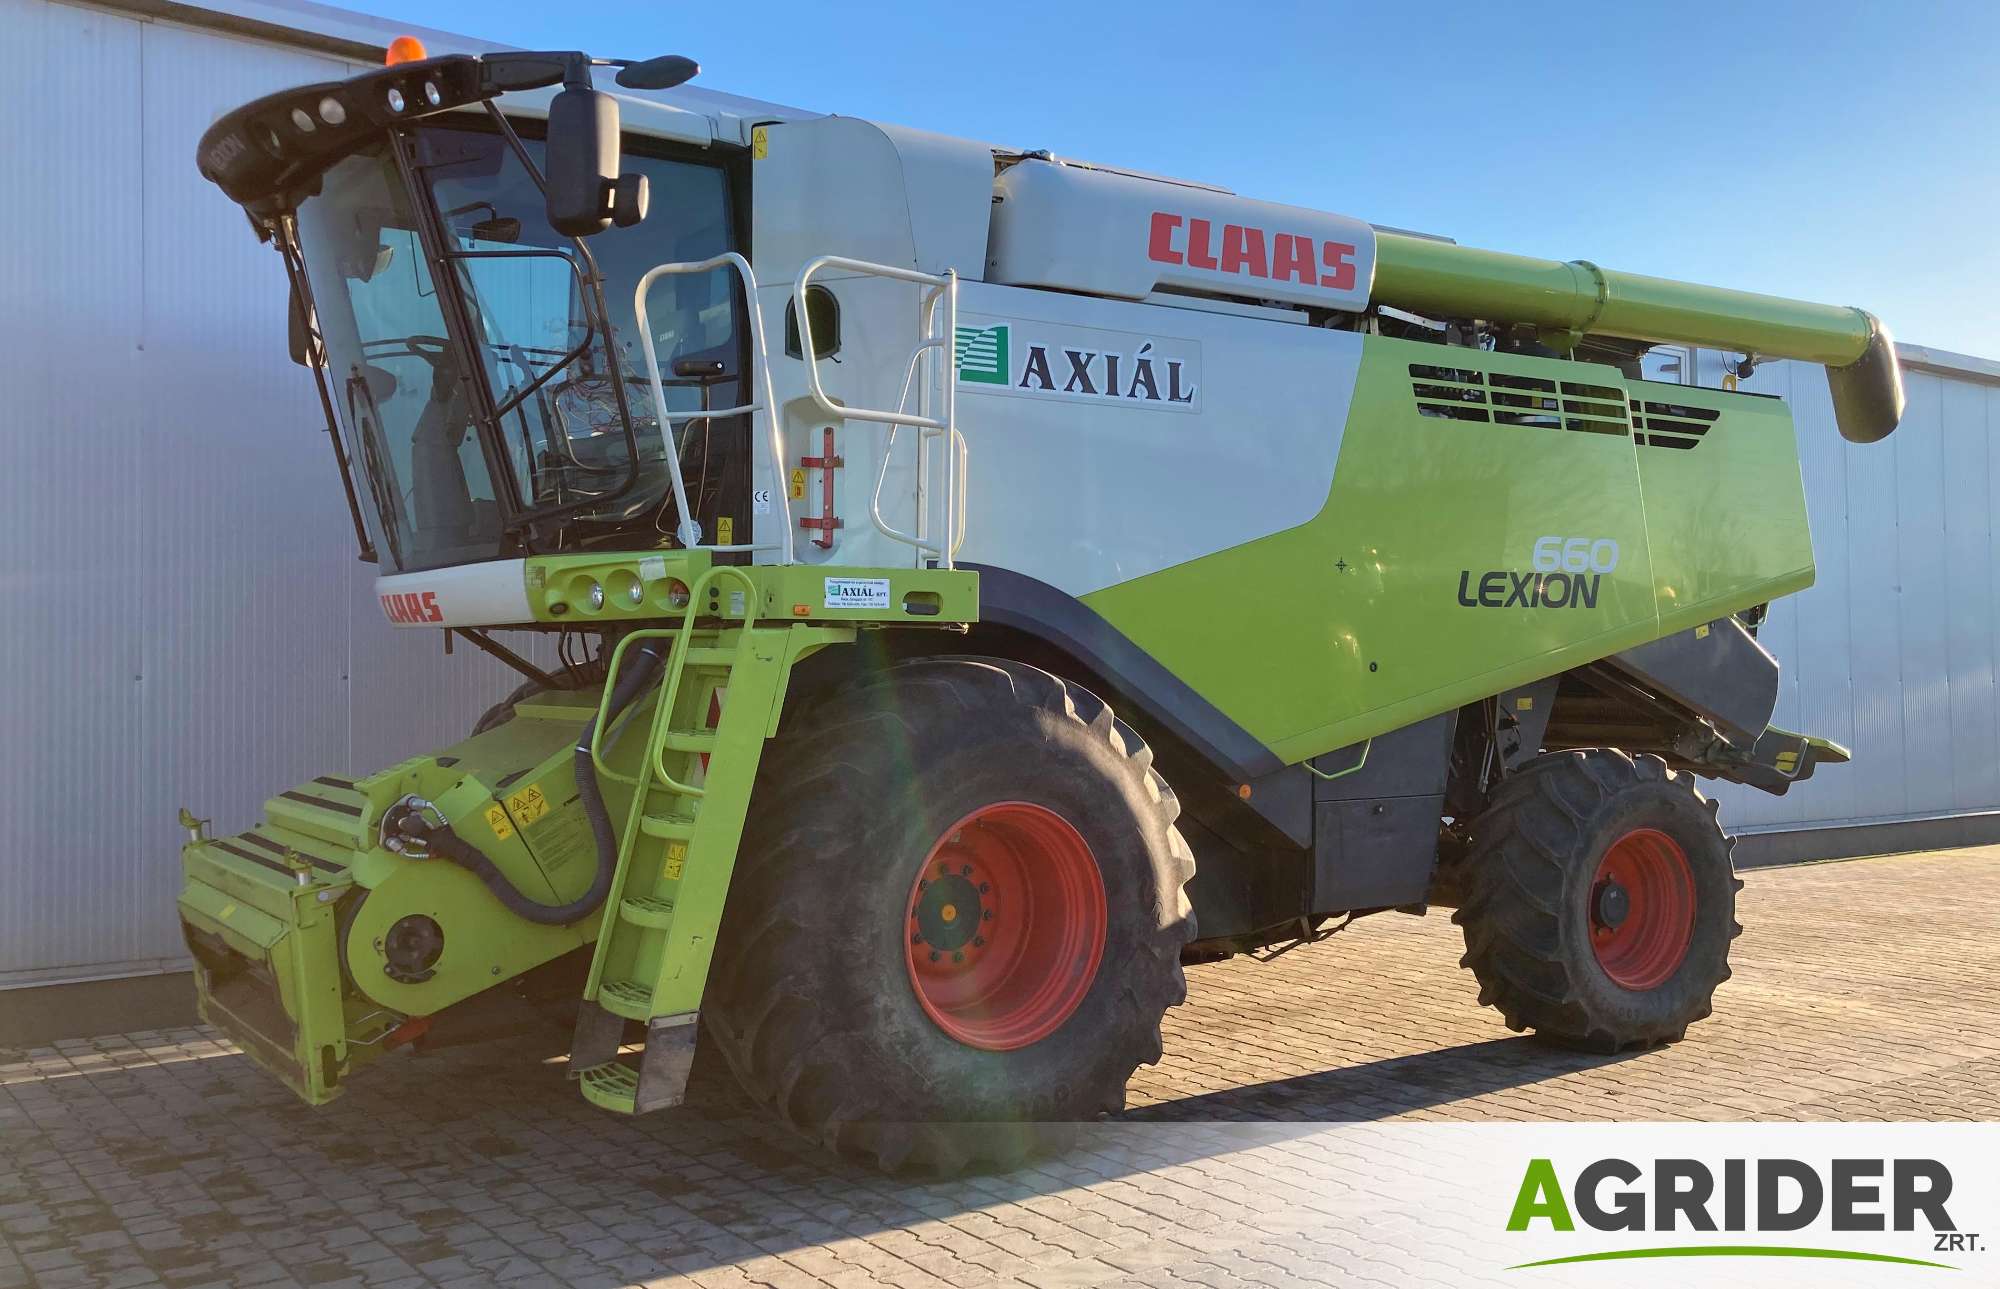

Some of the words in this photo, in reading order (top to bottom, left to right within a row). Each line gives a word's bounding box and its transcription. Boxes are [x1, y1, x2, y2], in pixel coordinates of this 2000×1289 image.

[1148, 211, 1357, 292] CLAAS
[1018, 342, 1195, 404] AXIÁL
[1532, 535, 1620, 574] 660
[841, 584, 874, 597] AXIÁL
[1457, 570, 1601, 609] LEXION
